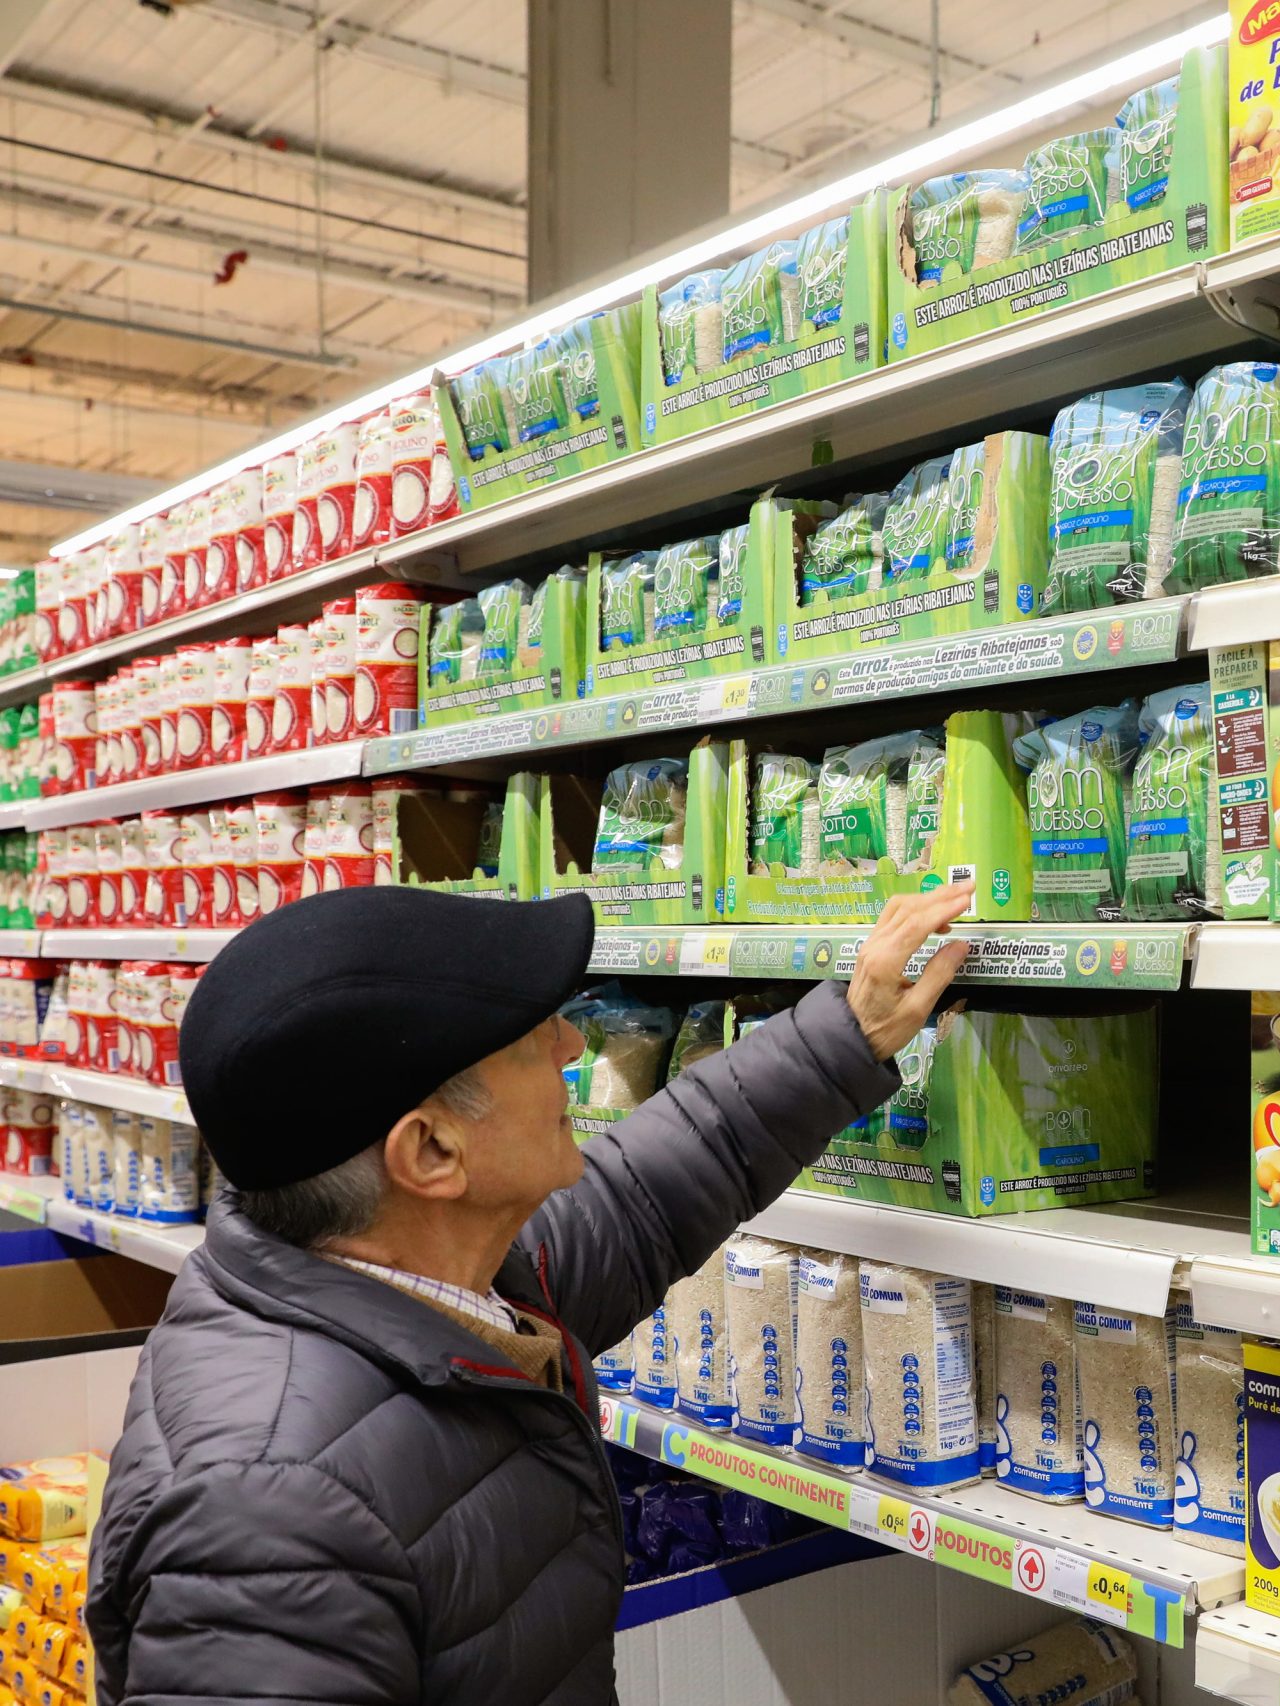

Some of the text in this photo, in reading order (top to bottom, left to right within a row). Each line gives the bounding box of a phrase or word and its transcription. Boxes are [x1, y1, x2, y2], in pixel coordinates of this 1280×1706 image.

[1240, 77, 1264, 103] de
[915, 220, 1174, 327] ESTE ARROZ PRODUZIDO NAS LEZÍRIAS RIBATEJANAS
[1010, 283, 1068, 313] 100% PORTUGUÊS
[661, 337, 847, 416] ESTE ARROZ PRODUZIDO NAS LEZÍRIAS RIBATEJANAS
[1133, 614, 1171, 638] BOM
[852, 658, 890, 676] arroz
[935, 645, 977, 663] Lezírias
[980, 635, 1048, 659] Ribatejanas
[1216, 648, 1246, 665] FACILE
[833, 652, 1062, 697] normas de produção amigas do ambiente da saúde.
[1213, 659, 1259, 678] PRÉPARER
[1030, 767, 1104, 808] BOM
[1031, 807, 1104, 833] SUCESSO
[734, 1266, 760, 1278] COMUM
[868, 1287, 904, 1303] COMUM
[1099, 1316, 1132, 1331] COMUM
[1248, 1396, 1268, 1412] Puré
[1270, 1402, 1280, 1414] de
[741, 1419, 775, 1433] CONTINENTE
[805, 1435, 840, 1450] CONTINENTE
[876, 1455, 916, 1472] CONTINENTE
[1013, 1465, 1051, 1483] CONTINENTE
[690, 1441, 846, 1511] PRODUTOS CONTINENTE
[1108, 1494, 1153, 1511] CONTINENTE
[882, 1514, 904, 1533] €0,64
[934, 1527, 1013, 1571] RODUTOS
[1093, 1577, 1125, 1600] €0,64
[1253, 1575, 1279, 1598] 200g
